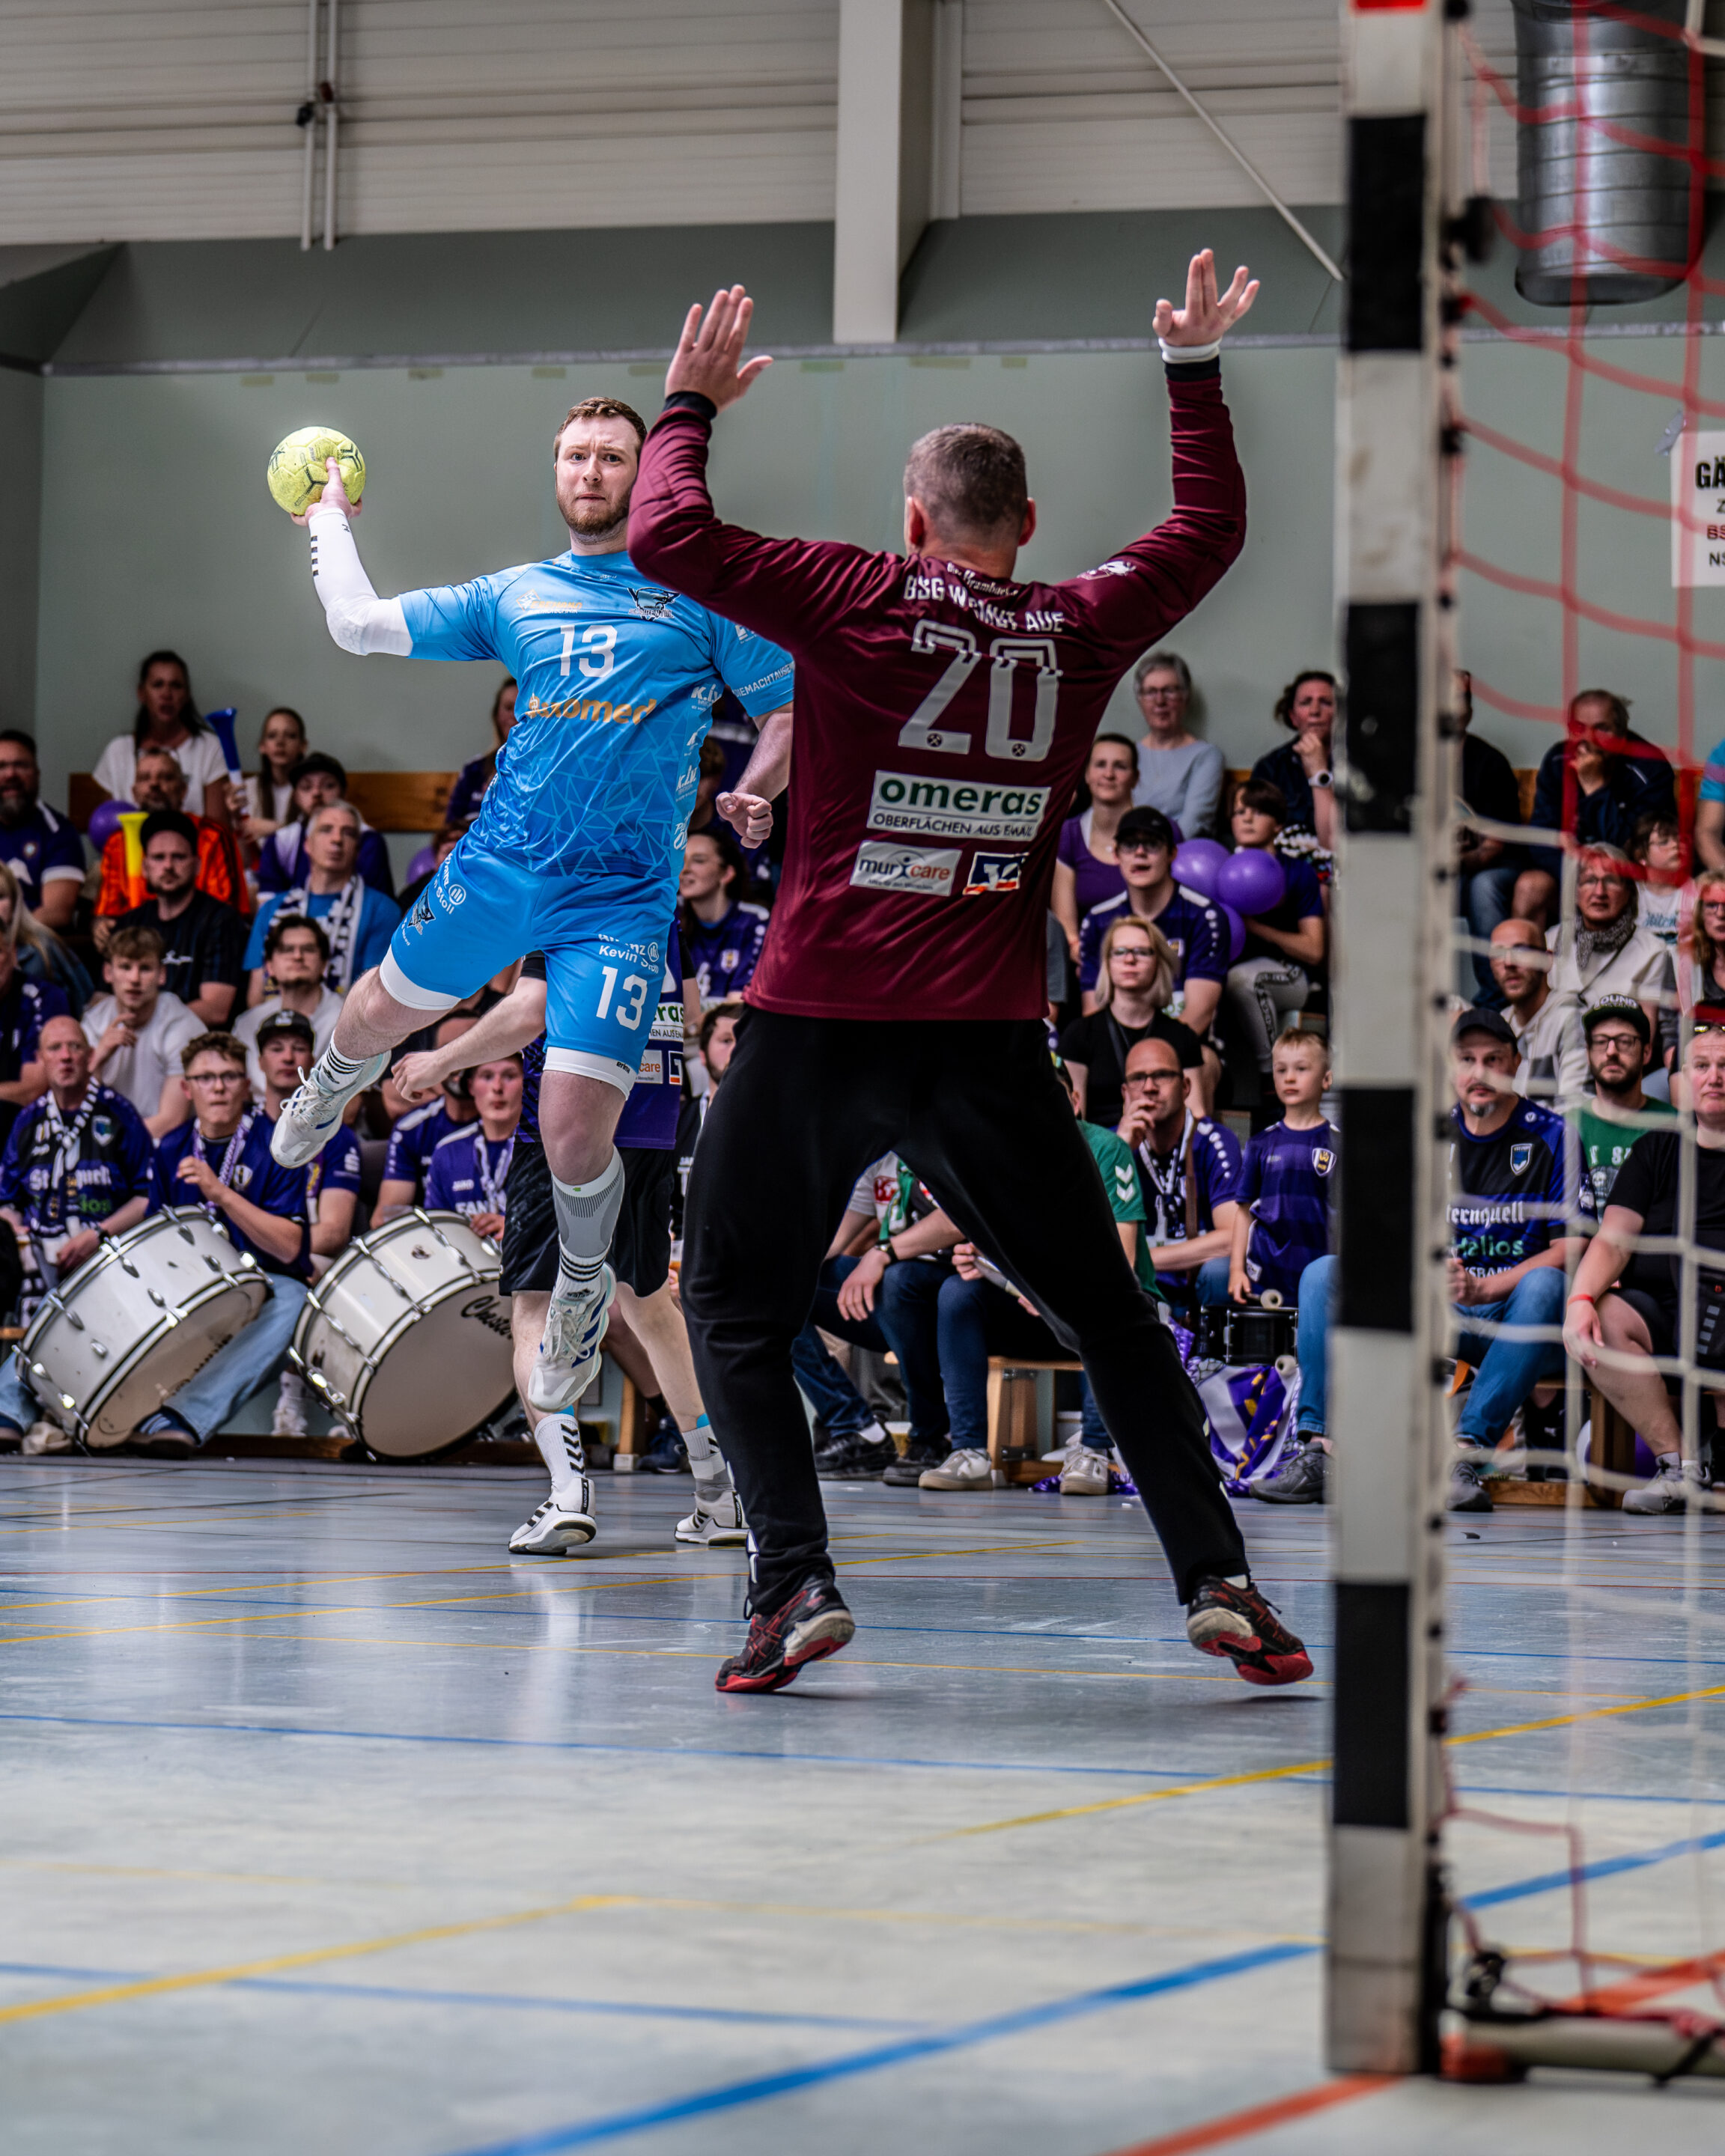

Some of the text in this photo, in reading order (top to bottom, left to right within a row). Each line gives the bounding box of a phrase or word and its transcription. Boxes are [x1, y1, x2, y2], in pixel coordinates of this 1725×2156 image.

[904, 574, 946, 601] BSG
[1024, 610, 1065, 632] AUE
[560, 624, 618, 677] 13
[898, 619, 1064, 763] 20
[880, 779, 1041, 815] omeras
[873, 813, 971, 835] OBERFLÄCHEN
[974, 823, 1000, 835] AUS
[599, 945, 638, 963] Kevin
[596, 965, 648, 1031] 13
